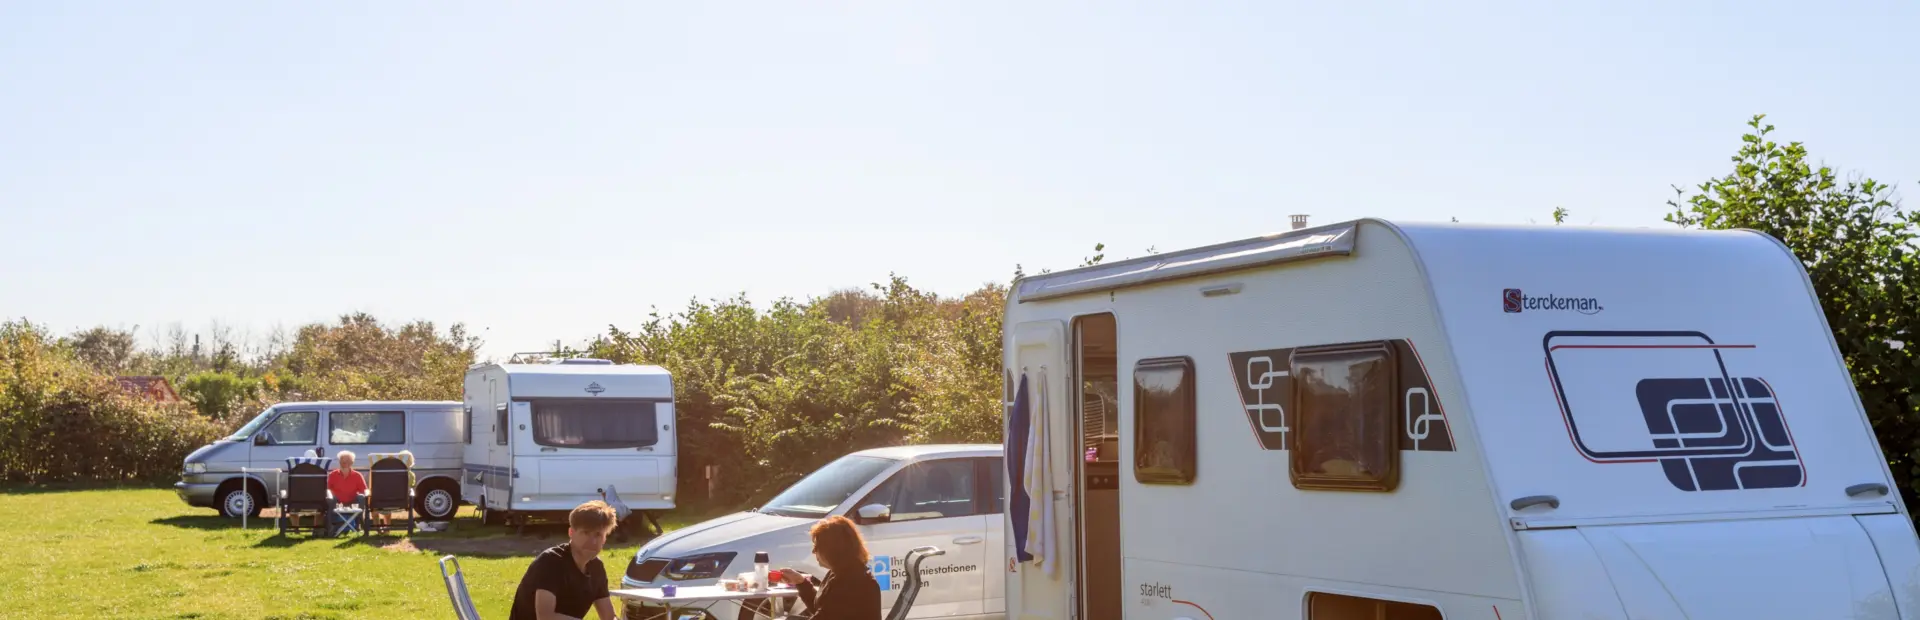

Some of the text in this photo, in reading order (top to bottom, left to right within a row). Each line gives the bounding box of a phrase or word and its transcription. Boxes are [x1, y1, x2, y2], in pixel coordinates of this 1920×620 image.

[890, 556, 904, 566] Ihr
[891, 564, 977, 578] Dianiestationen
[891, 581, 900, 590] in
[1140, 581, 1172, 599] starlett
